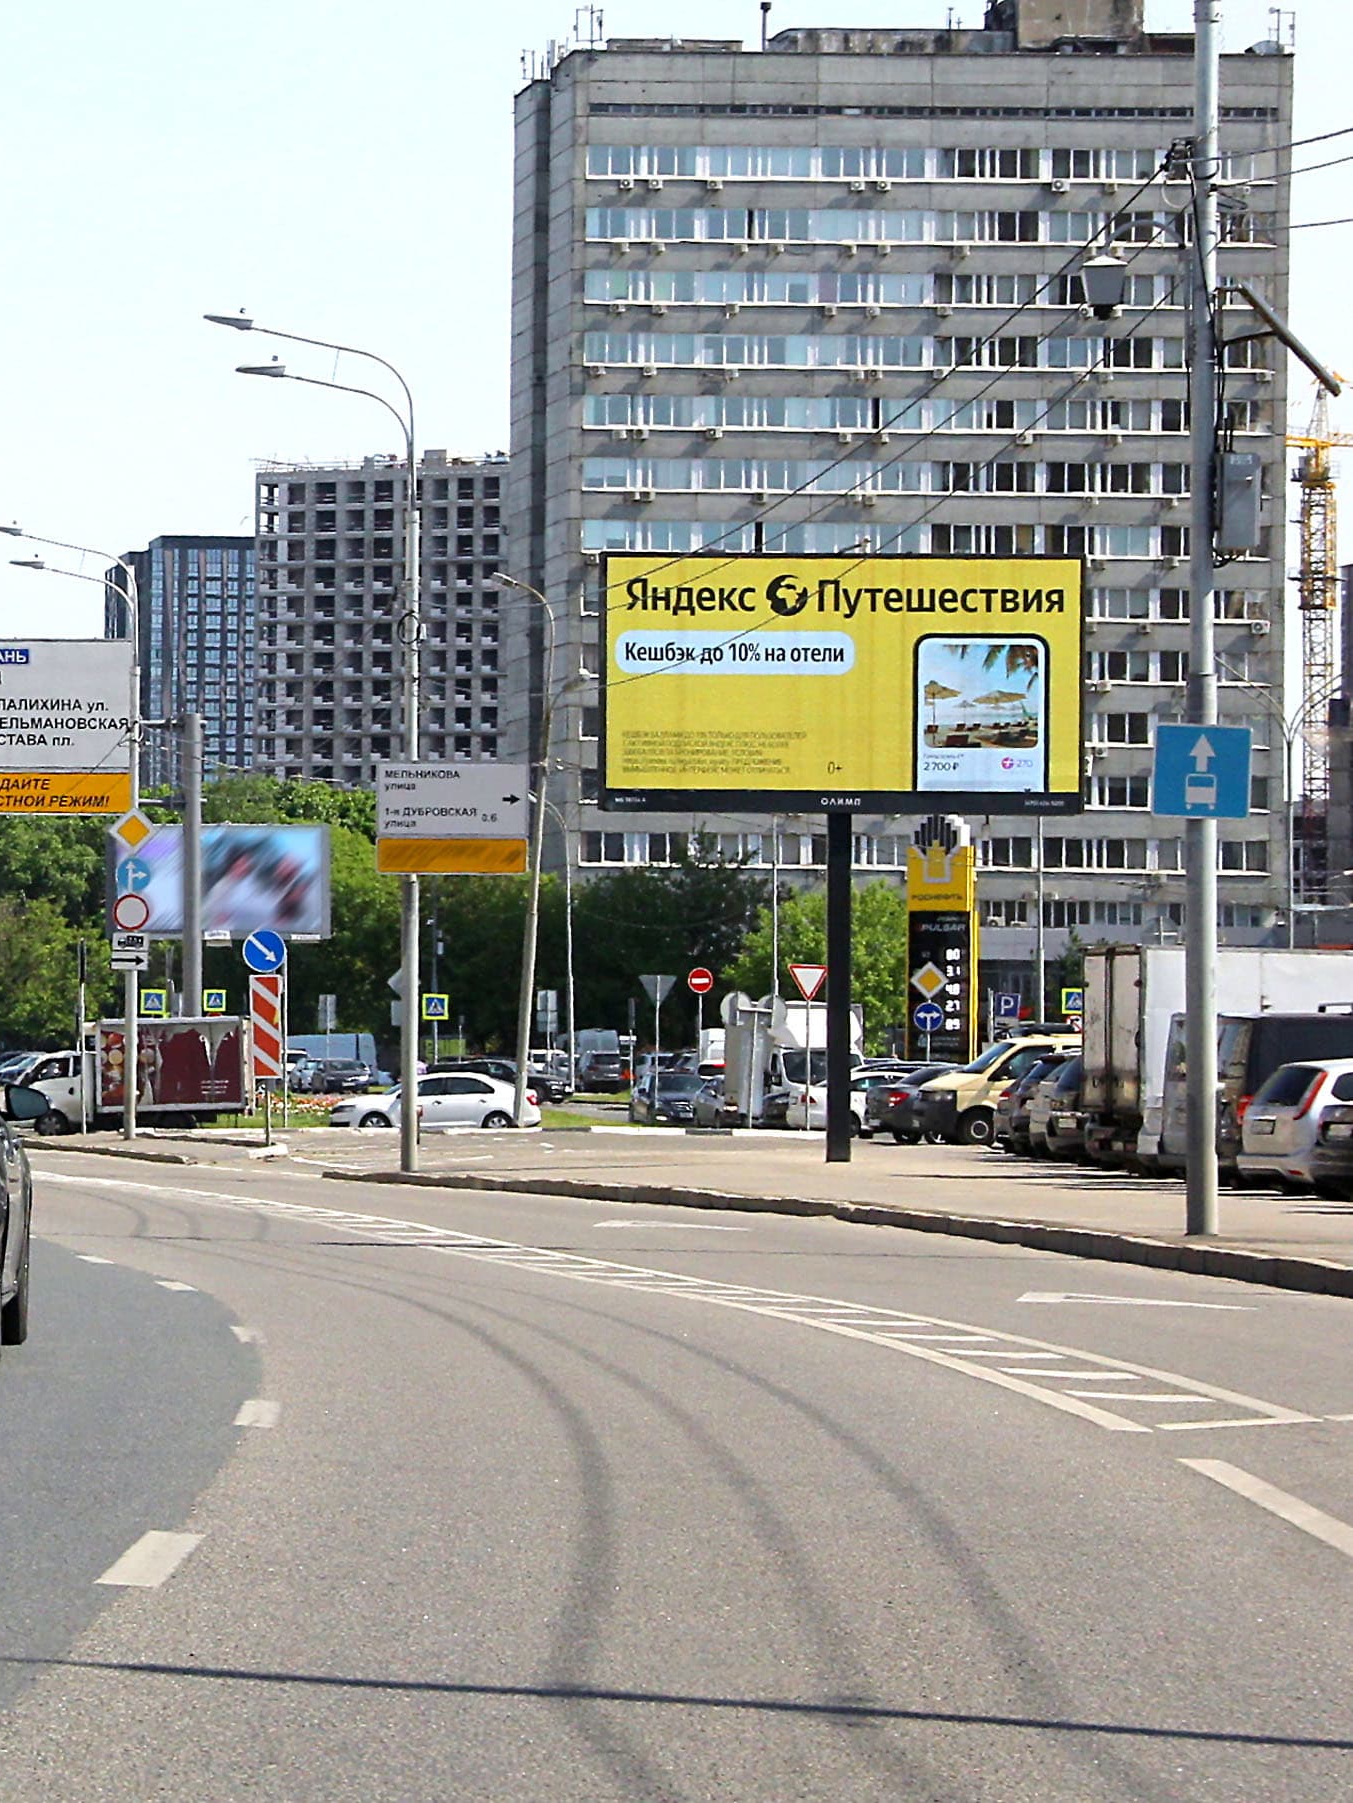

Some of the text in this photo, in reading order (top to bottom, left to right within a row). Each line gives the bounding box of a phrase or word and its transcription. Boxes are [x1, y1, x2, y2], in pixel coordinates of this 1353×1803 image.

[627, 579, 1065, 618] Яндекс Путешествия
[625, 642, 844, 665] Кешбэк до 10% на отели
[87, 702, 109, 713] ул.
[52, 737, 74, 746] пл.
[827, 762, 843, 775] 0+
[384, 769, 460, 779] МЕЛЬНИКОВА
[384, 783, 416, 791] улица
[48, 795, 110, 808] РЕЖИМ!
[820, 797, 861, 807] ОЛИМП
[402, 807, 477, 817] ДУБРОВСКАЯ
[384, 821, 417, 829] улица
